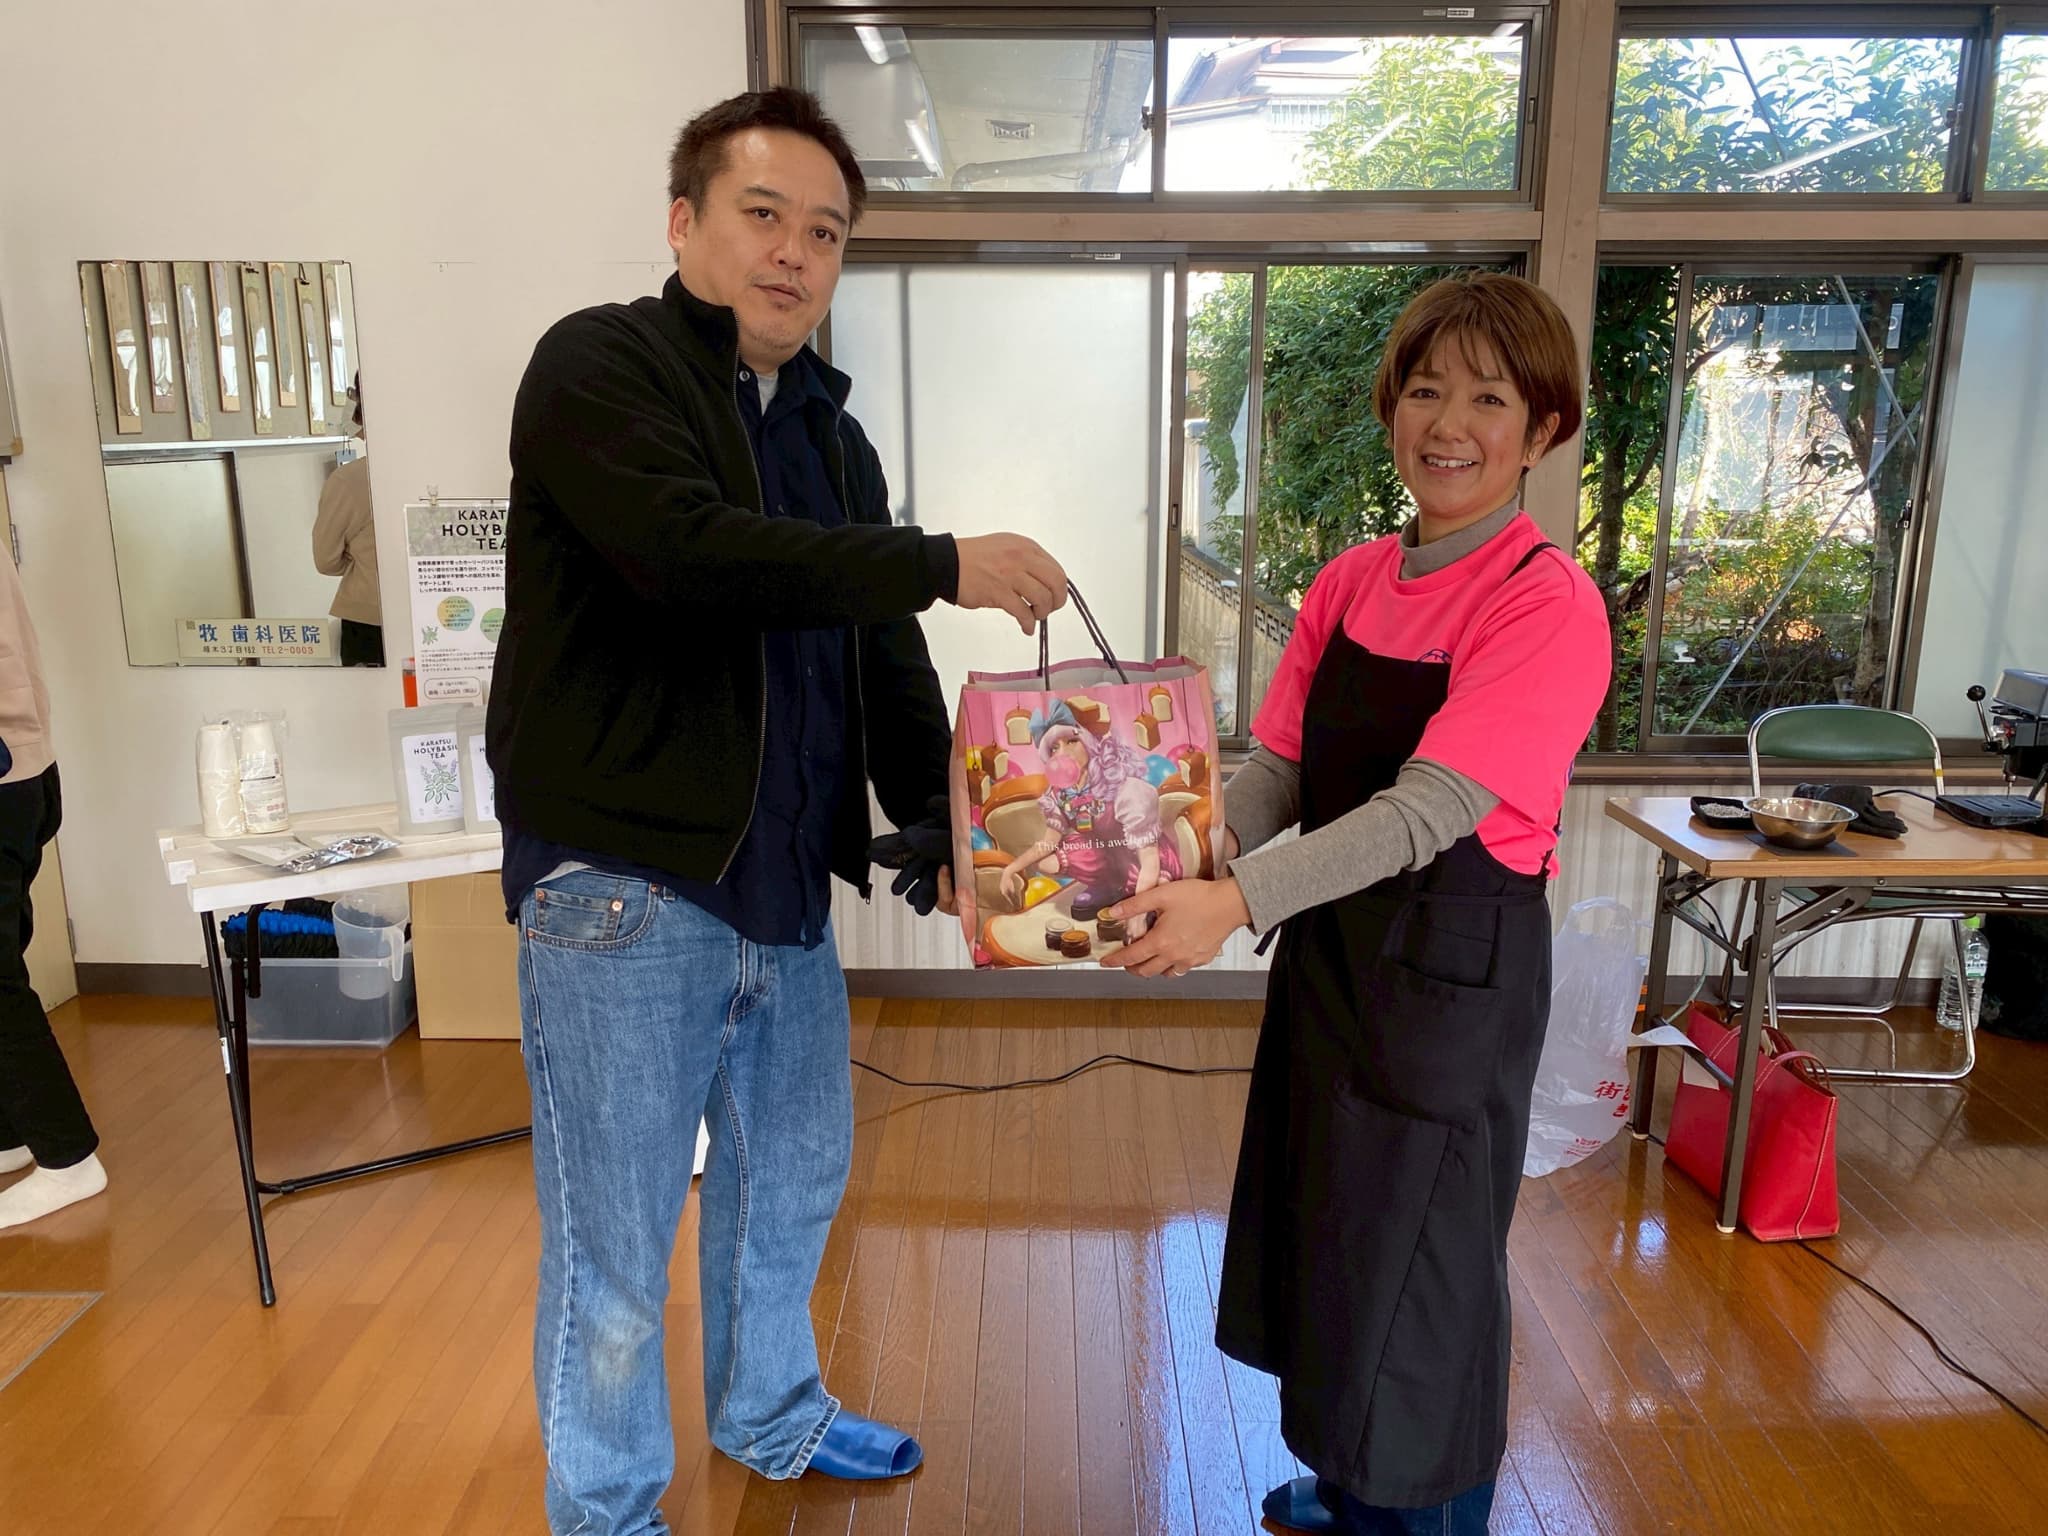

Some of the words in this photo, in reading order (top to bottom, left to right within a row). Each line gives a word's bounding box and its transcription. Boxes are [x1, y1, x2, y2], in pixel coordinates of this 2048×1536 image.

[198, 623, 218, 643] 牧
[231, 624, 321, 644] 歯科医院
[261, 645, 275, 655] TEL
[420, 738, 452, 747] KARATSU
[430, 752, 446, 760] TEA
[1037, 841, 1059, 852] This
[1062, 839, 1092, 851] bread
[1095, 838, 1105, 849] is
